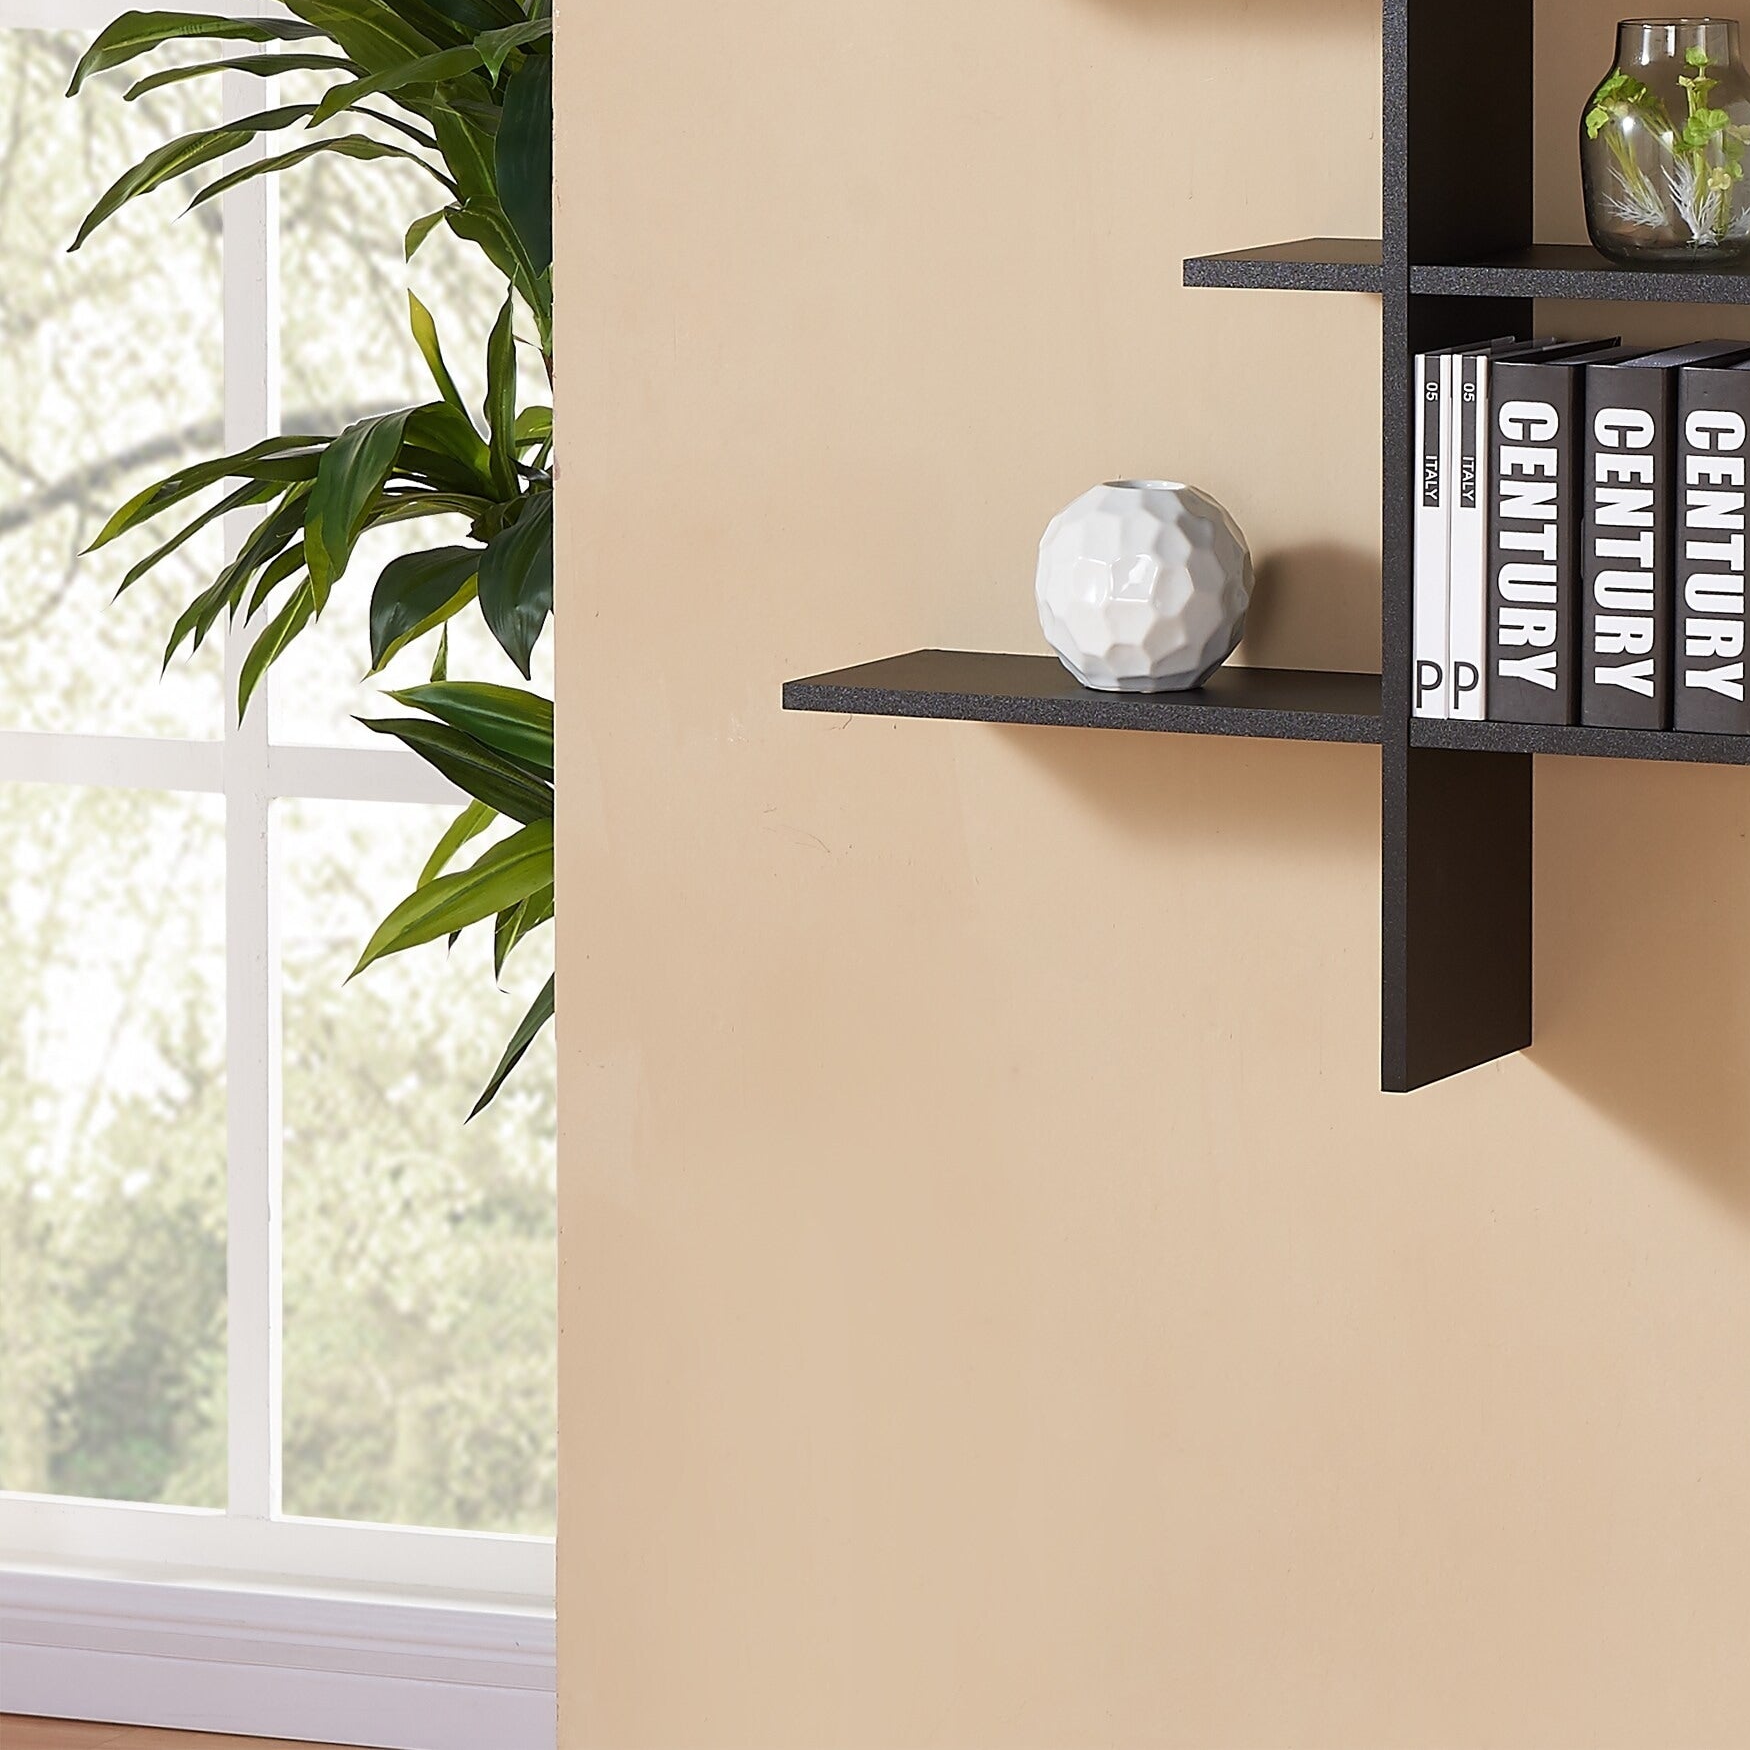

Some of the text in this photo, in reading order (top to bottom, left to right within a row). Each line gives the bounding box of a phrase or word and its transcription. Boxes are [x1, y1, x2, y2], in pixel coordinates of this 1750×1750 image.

[1424, 382, 1439, 500] 05 ITALY
[1462, 382, 1475, 501] 05 ITALY
[1497, 400, 1559, 691] CENTURY
[1594, 408, 1655, 698] CENTURY
[1685, 410, 1746, 702] CENTURY
[1416, 660, 1443, 709] P
[1453, 661, 1479, 710] P
